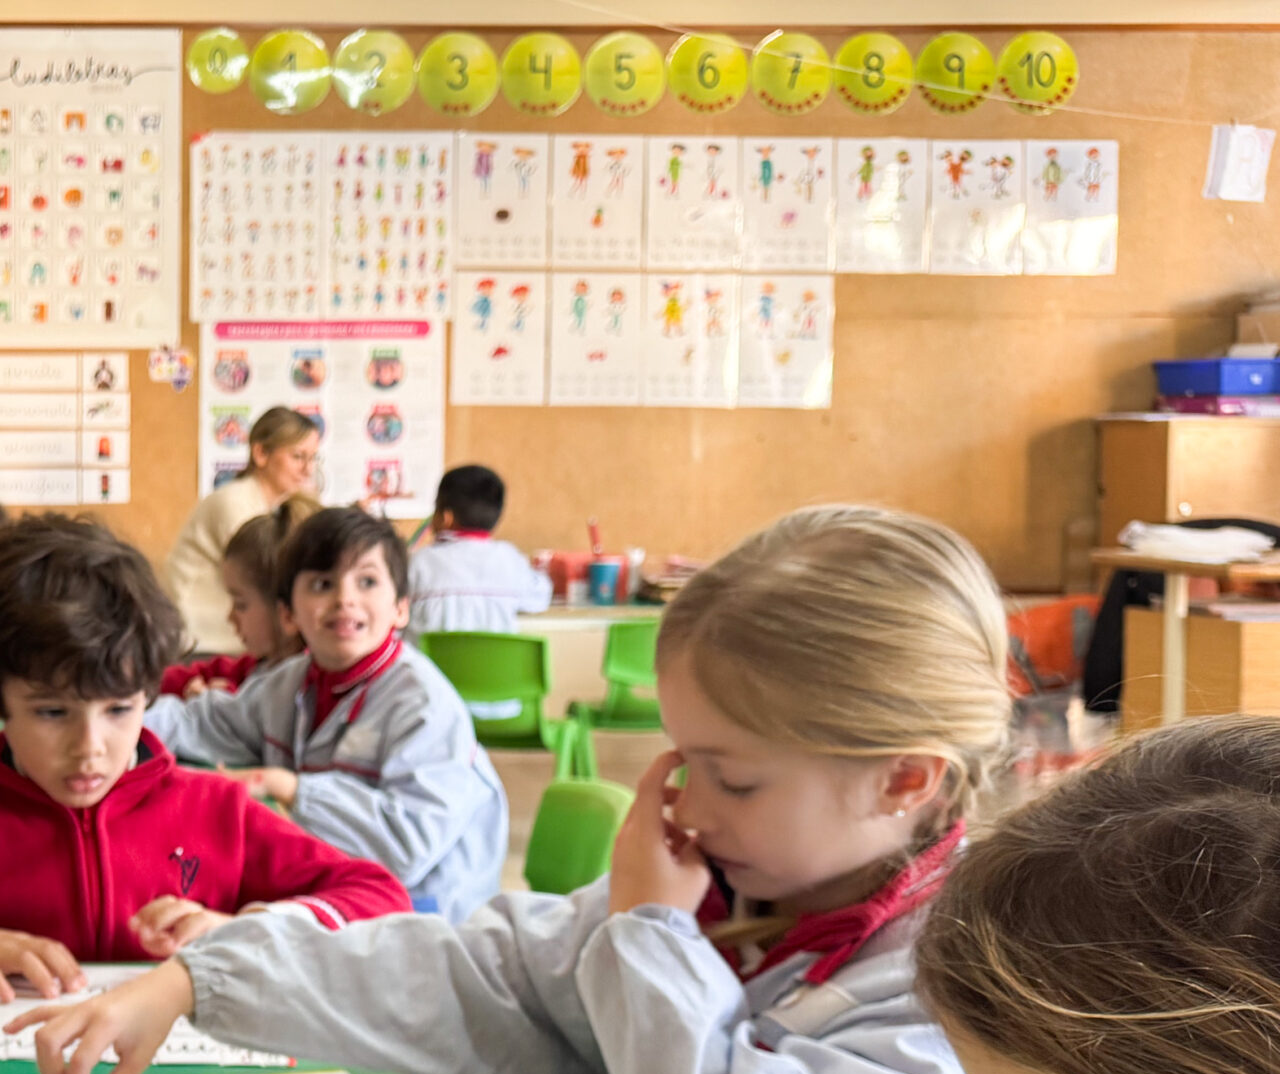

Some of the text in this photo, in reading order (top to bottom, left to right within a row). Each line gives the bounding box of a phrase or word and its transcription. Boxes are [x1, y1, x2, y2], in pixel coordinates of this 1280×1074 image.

[207, 46, 229, 77] 0
[364, 50, 388, 90] 2
[446, 54, 470, 92] 3
[529, 52, 553, 91] 4
[613, 53, 637, 91] 5
[697, 52, 720, 90] 6
[784, 53, 804, 90] 7
[861, 53, 886, 90] 8
[943, 53, 966, 90] 9
[1018, 51, 1058, 89] 10
